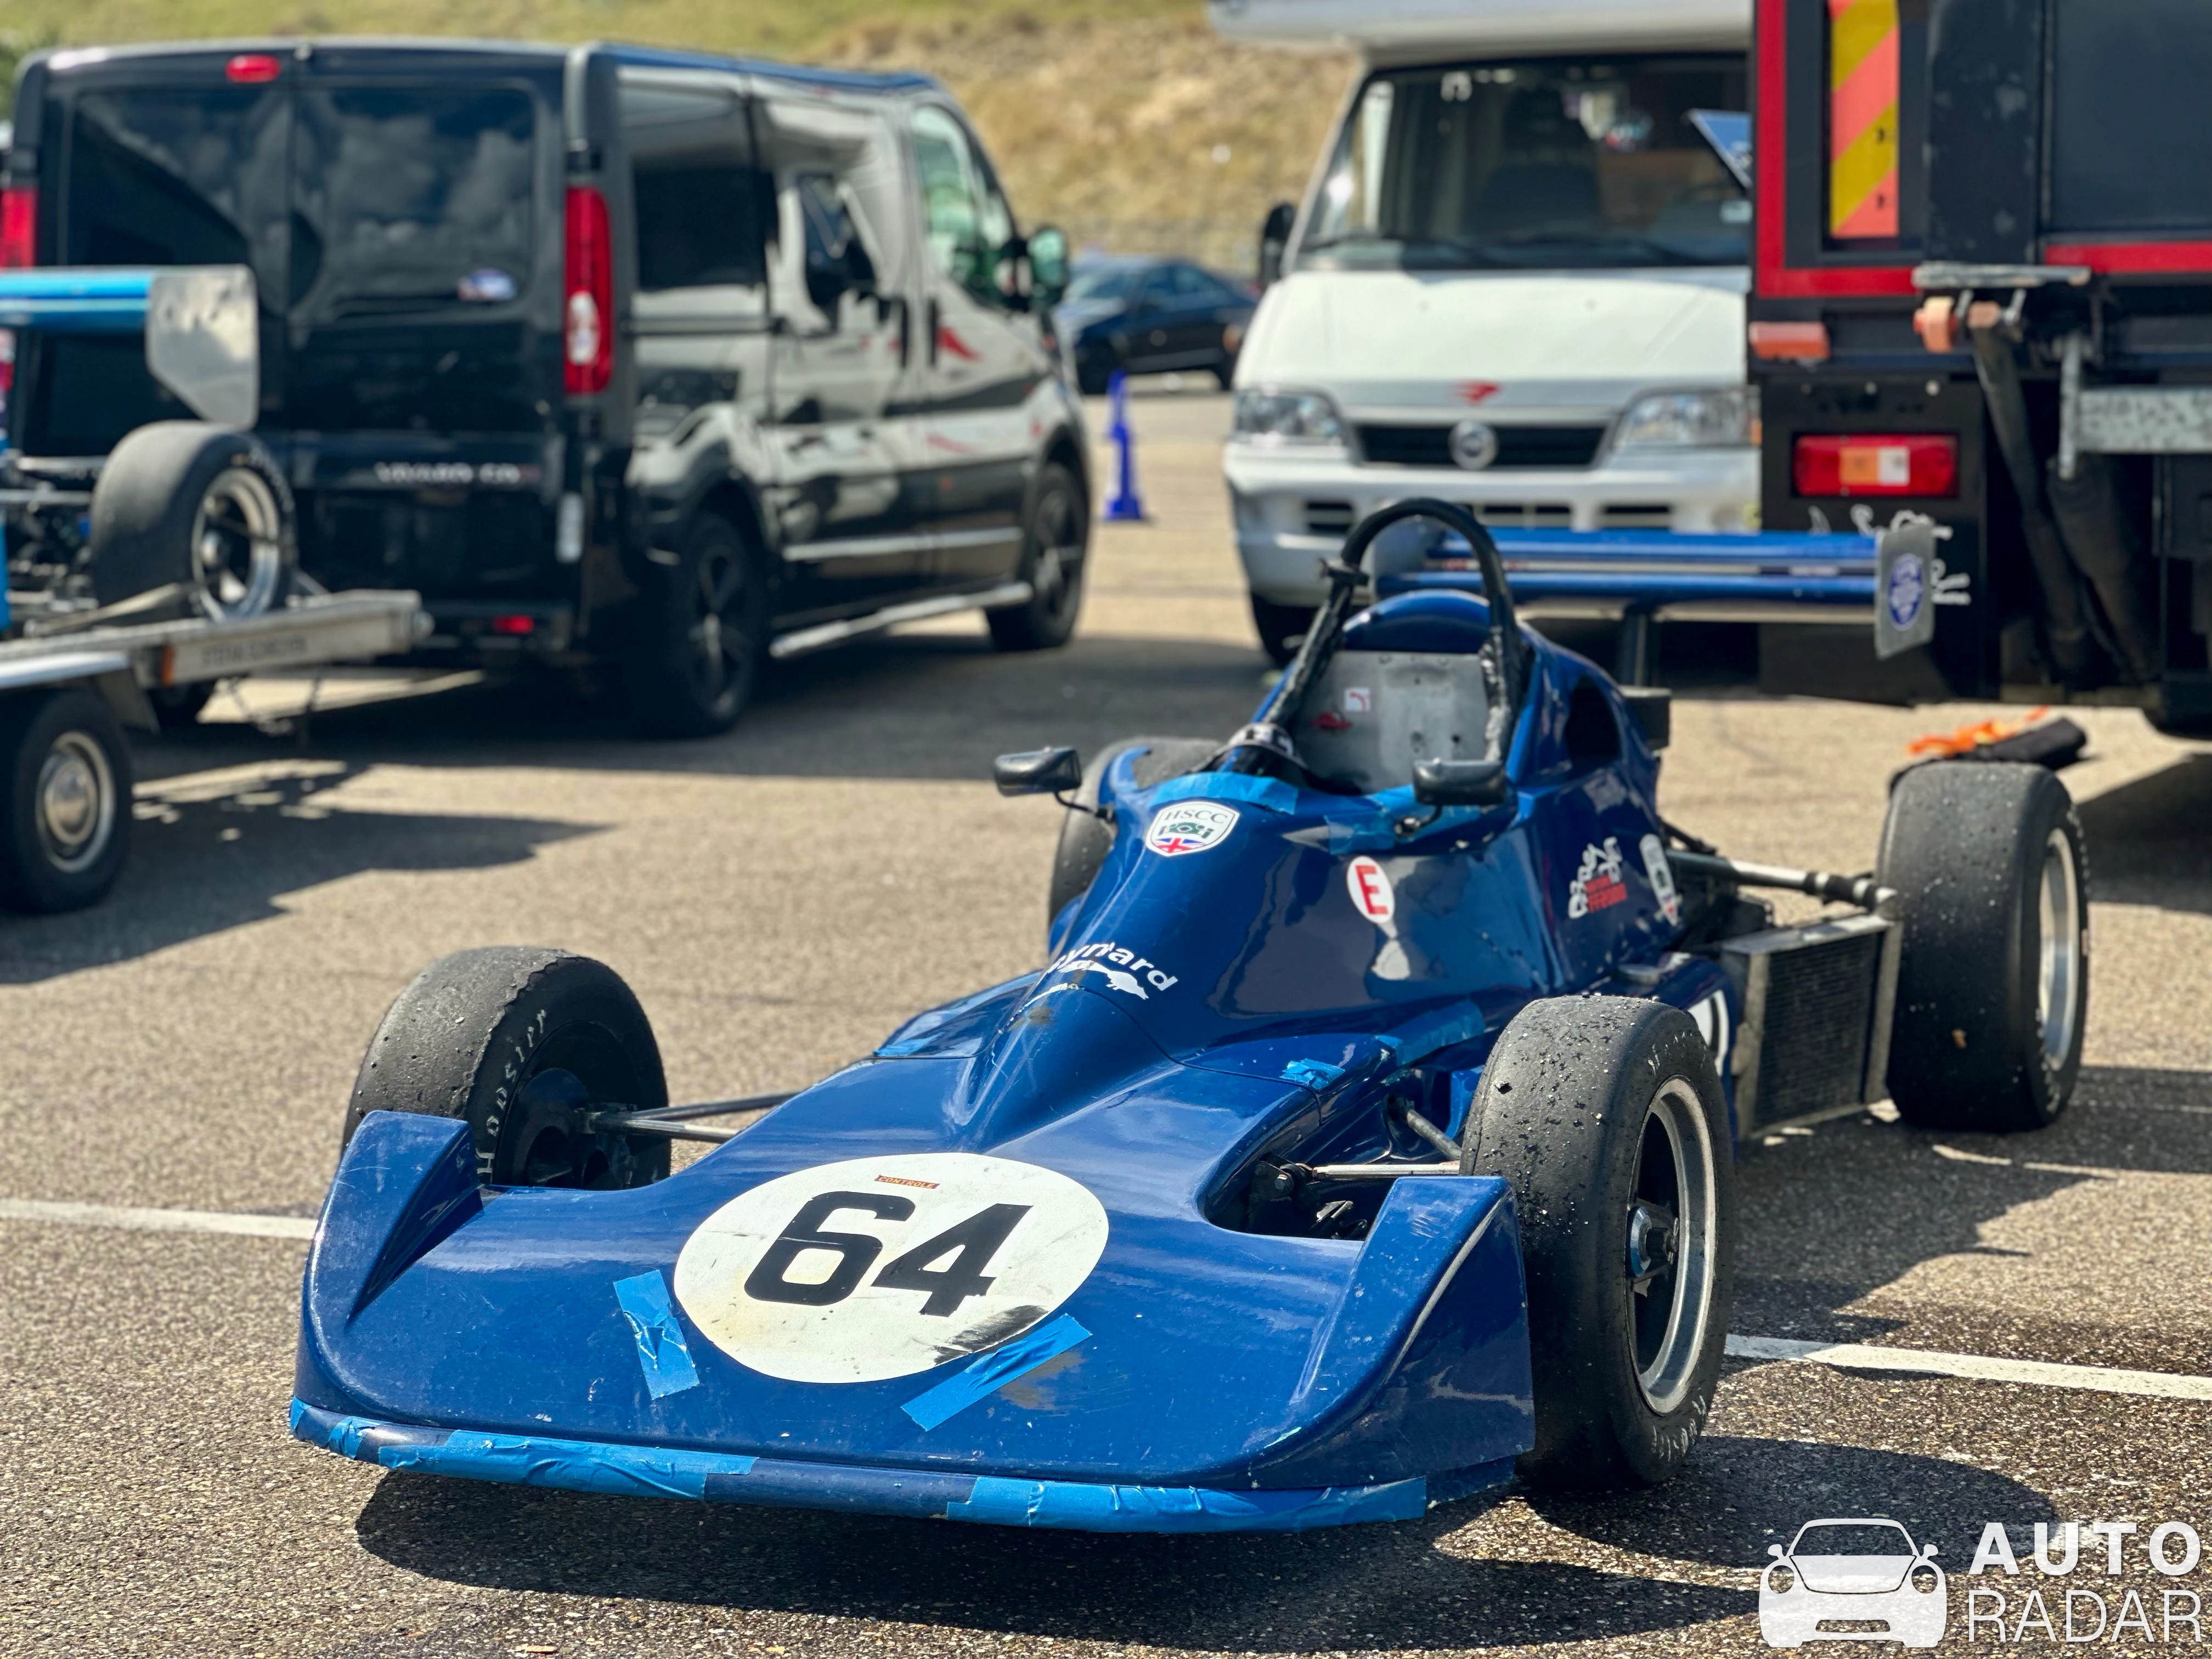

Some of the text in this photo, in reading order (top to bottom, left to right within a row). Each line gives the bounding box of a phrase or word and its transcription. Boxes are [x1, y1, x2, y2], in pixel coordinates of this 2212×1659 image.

[1165, 809, 1228, 824] HSCC
[1355, 865, 1389, 915] E
[1047, 941, 1178, 991] eynard
[878, 1177, 935, 1188] CONTROLE
[744, 1190, 1034, 1317] 64
